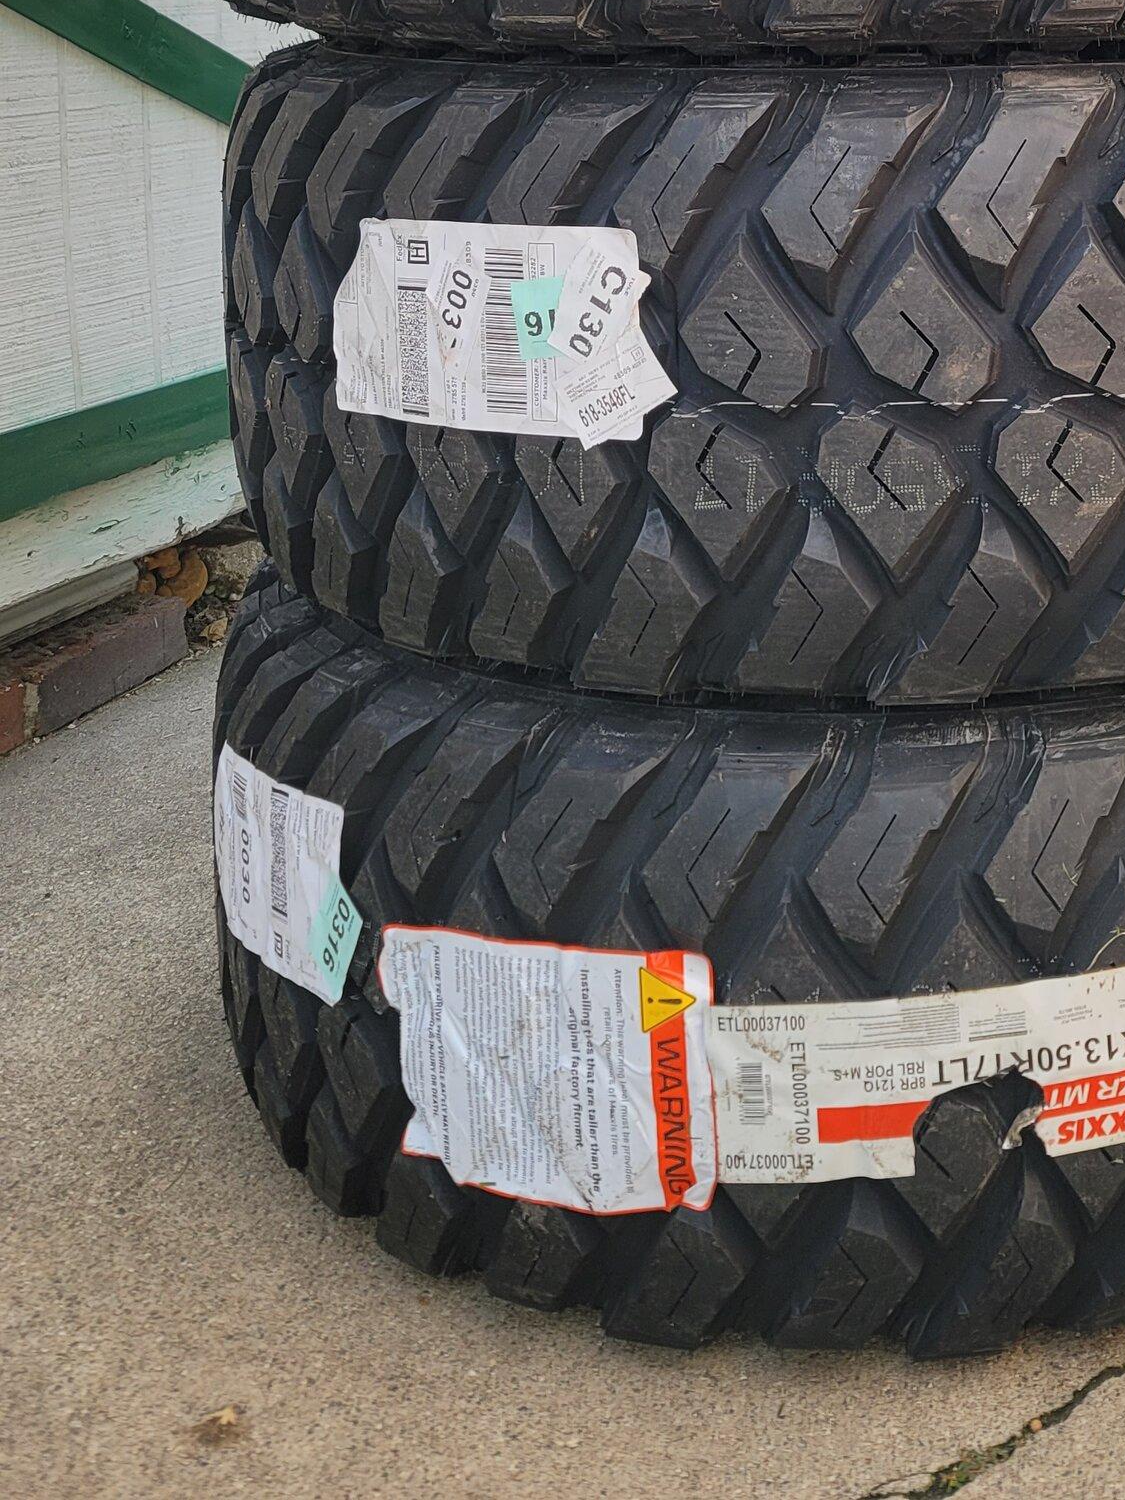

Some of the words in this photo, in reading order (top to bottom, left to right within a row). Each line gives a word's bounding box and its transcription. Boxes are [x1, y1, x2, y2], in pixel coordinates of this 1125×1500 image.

[442, 269, 473, 349] 003
[569, 266, 628, 358] C130
[579, 384, 635, 427] 618-3548FL
[241, 829, 251, 904] 0030
[323, 897, 350, 973] 0316
[433, 945, 442, 981] FAILURE
[580, 969, 594, 1026] Installing
[614, 969, 622, 1017] Attention:
[616, 1020, 625, 1039] This
[717, 1016, 805, 1032] ETL00037100
[428, 1040, 436, 1073] INJURY
[437, 1044, 447, 1081] VEHICLE
[587, 1057, 596, 1084] that
[866, 1064, 894, 1077] POR
[900, 1060, 925, 1074] RBL
[430, 1074, 437, 1086] OR
[570, 1056, 582, 1100] factory
[834, 1068, 861, 1082] M+S
[864, 1079, 896, 1093] 121Q
[901, 1077, 926, 1090] 8PR
[587, 1087, 596, 1106] are
[608, 1088, 616, 1098] of
[789, 1042, 811, 1145] ETL00037100
[1044, 1082, 1091, 1111] MT
[441, 1114, 449, 1134] MAY
[588, 1108, 598, 1140] taller
[621, 1105, 629, 1129] must
[657, 1036, 692, 1196] WARNING
[443, 1134, 451, 1167] RESULT
[590, 1143, 600, 1171] than
[622, 1145, 633, 1185] provided
[726, 1154, 814, 1170] ETL00037100
[592, 1173, 602, 1192] the
